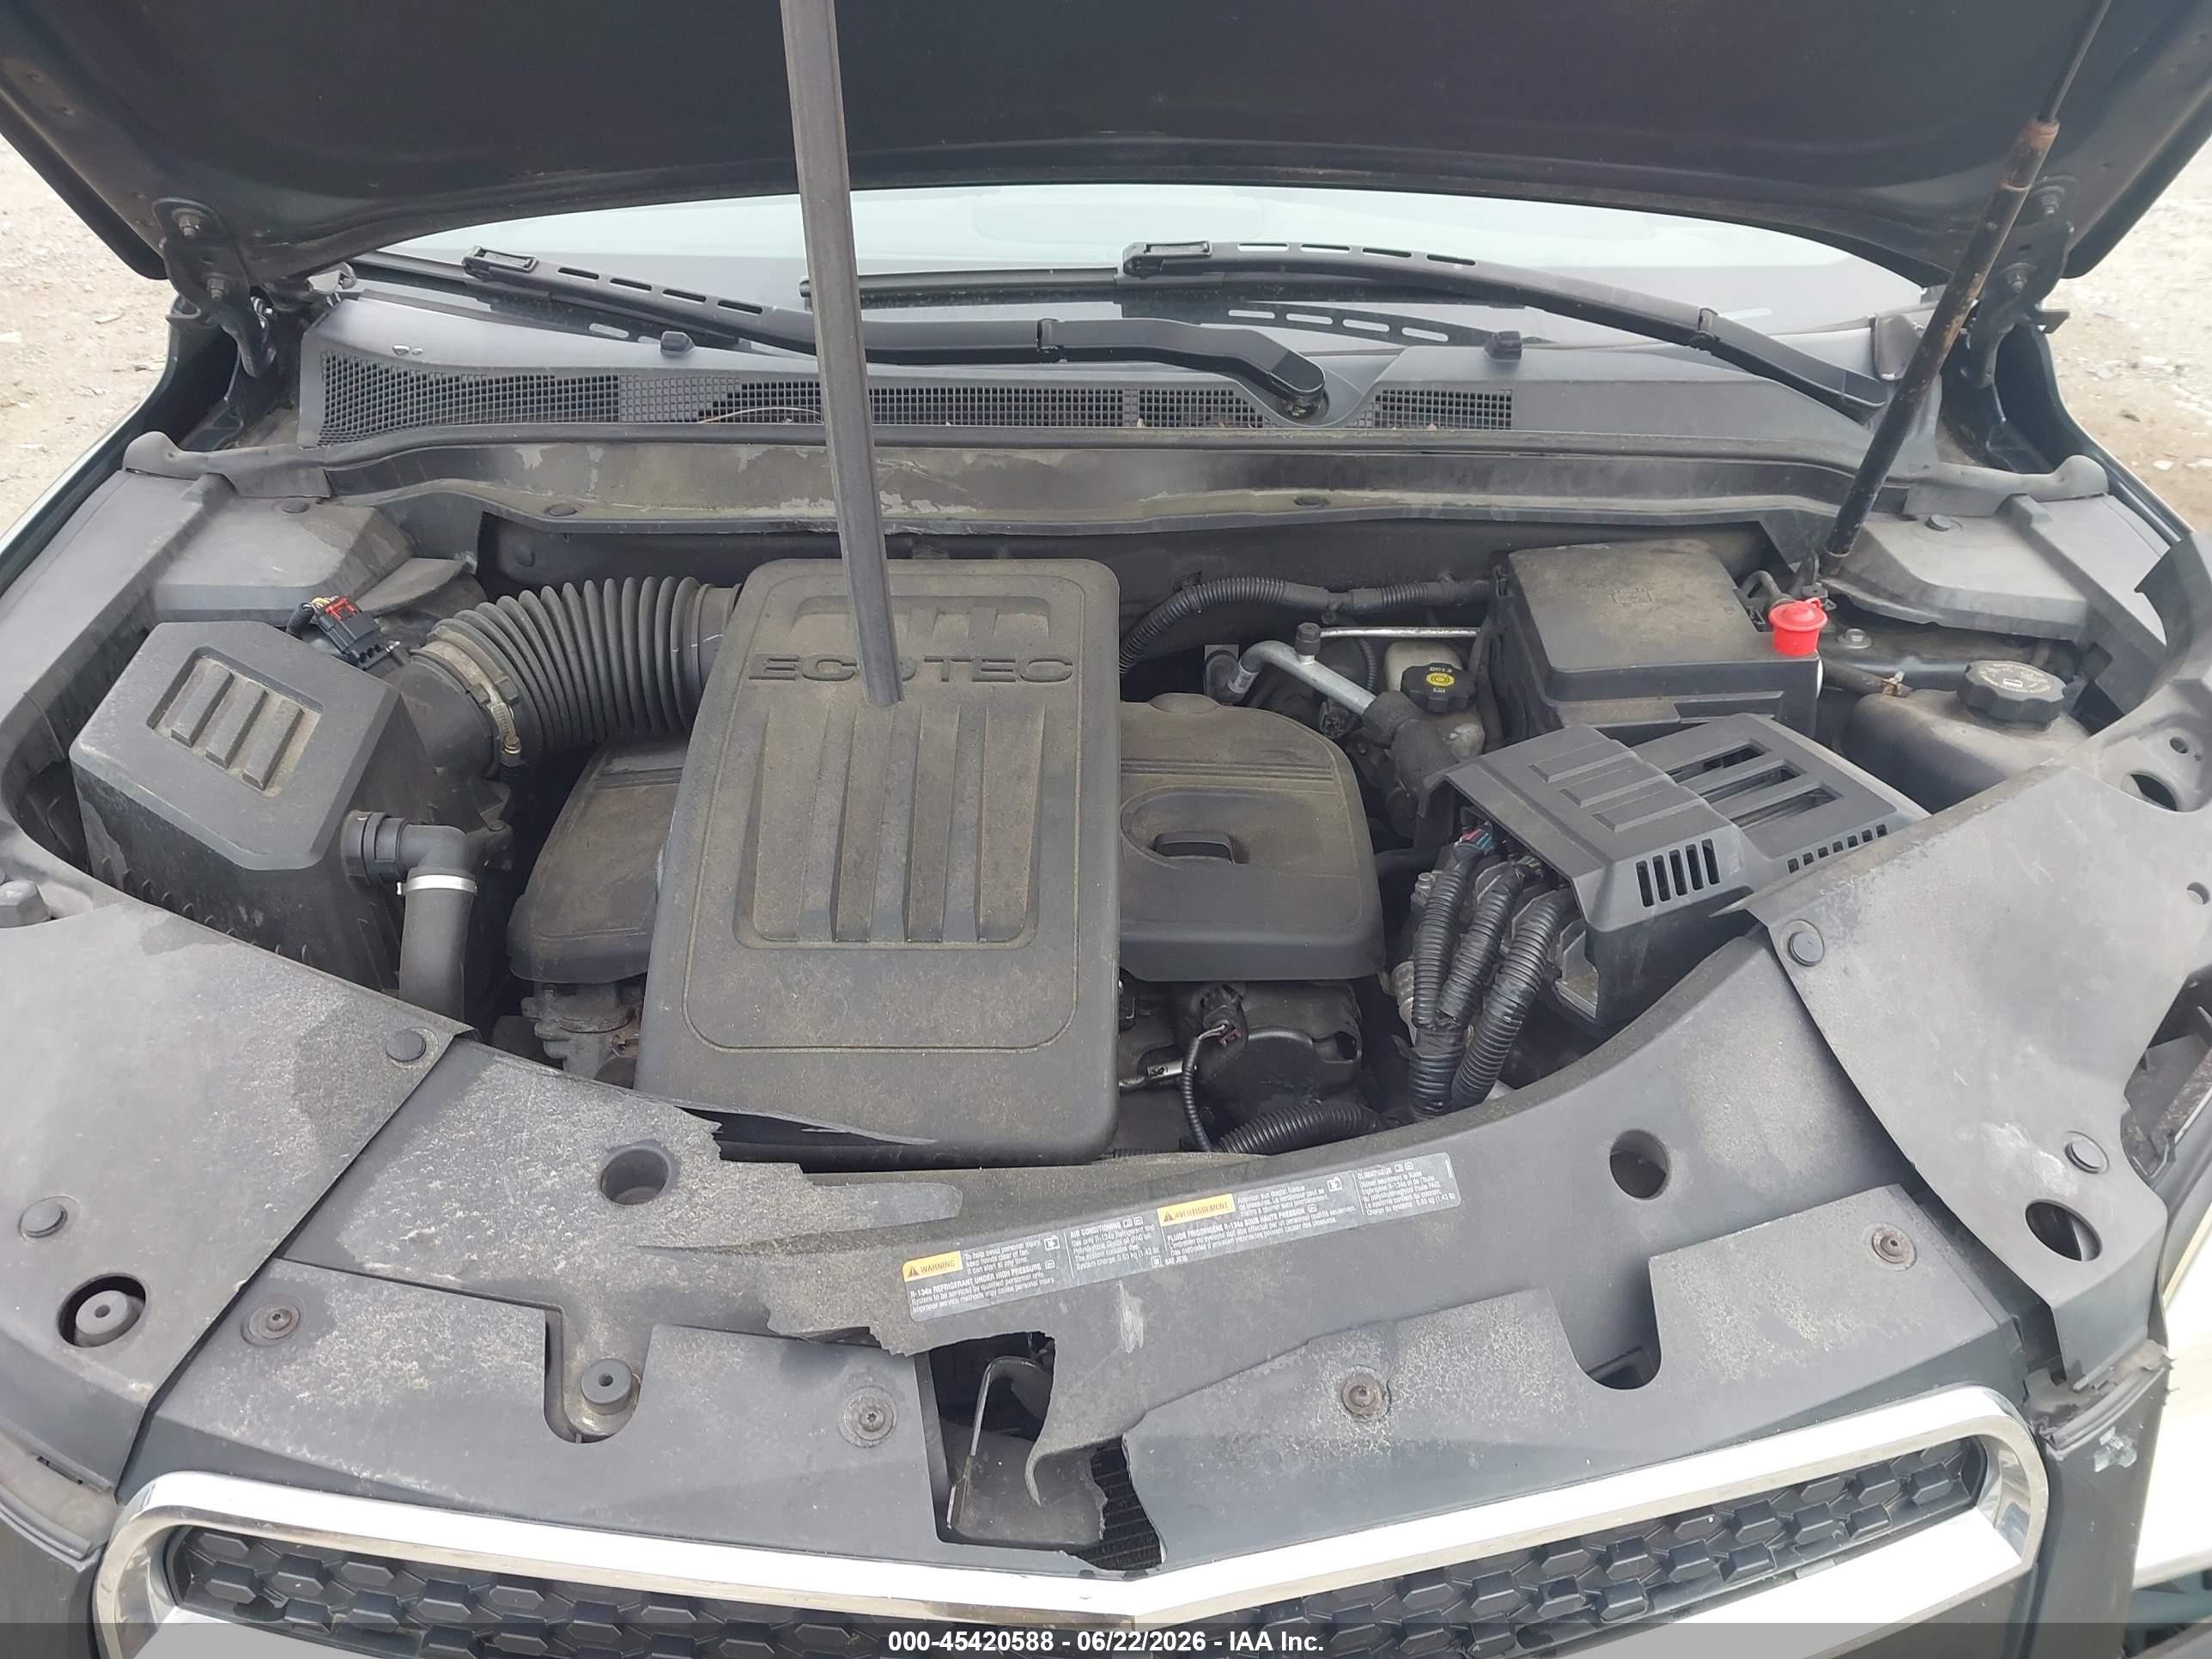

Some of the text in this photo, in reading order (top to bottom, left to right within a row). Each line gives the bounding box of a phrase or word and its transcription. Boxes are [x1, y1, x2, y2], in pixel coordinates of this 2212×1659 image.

[748, 653, 1073, 684] ECTEC
[1175, 1202, 1228, 1219] AVERTISSEMENT
[1259, 1212, 1277, 1223] HAUTE
[1278, 1206, 1305, 1219] PRESSION
[1070, 1221, 1121, 1238] AIR CONDITIONING
[972, 1251, 985, 1260] help
[1000, 1243, 1025, 1254] personal
[981, 1255, 998, 1264] hands
[998, 1252, 1012, 1261] clear
[921, 1261, 955, 1273] WARNING
[983, 1262, 996, 1272] start
[910, 1263, 1042, 1297] R-134a REFRIGERANT UNDER HIGH PRESSURE
